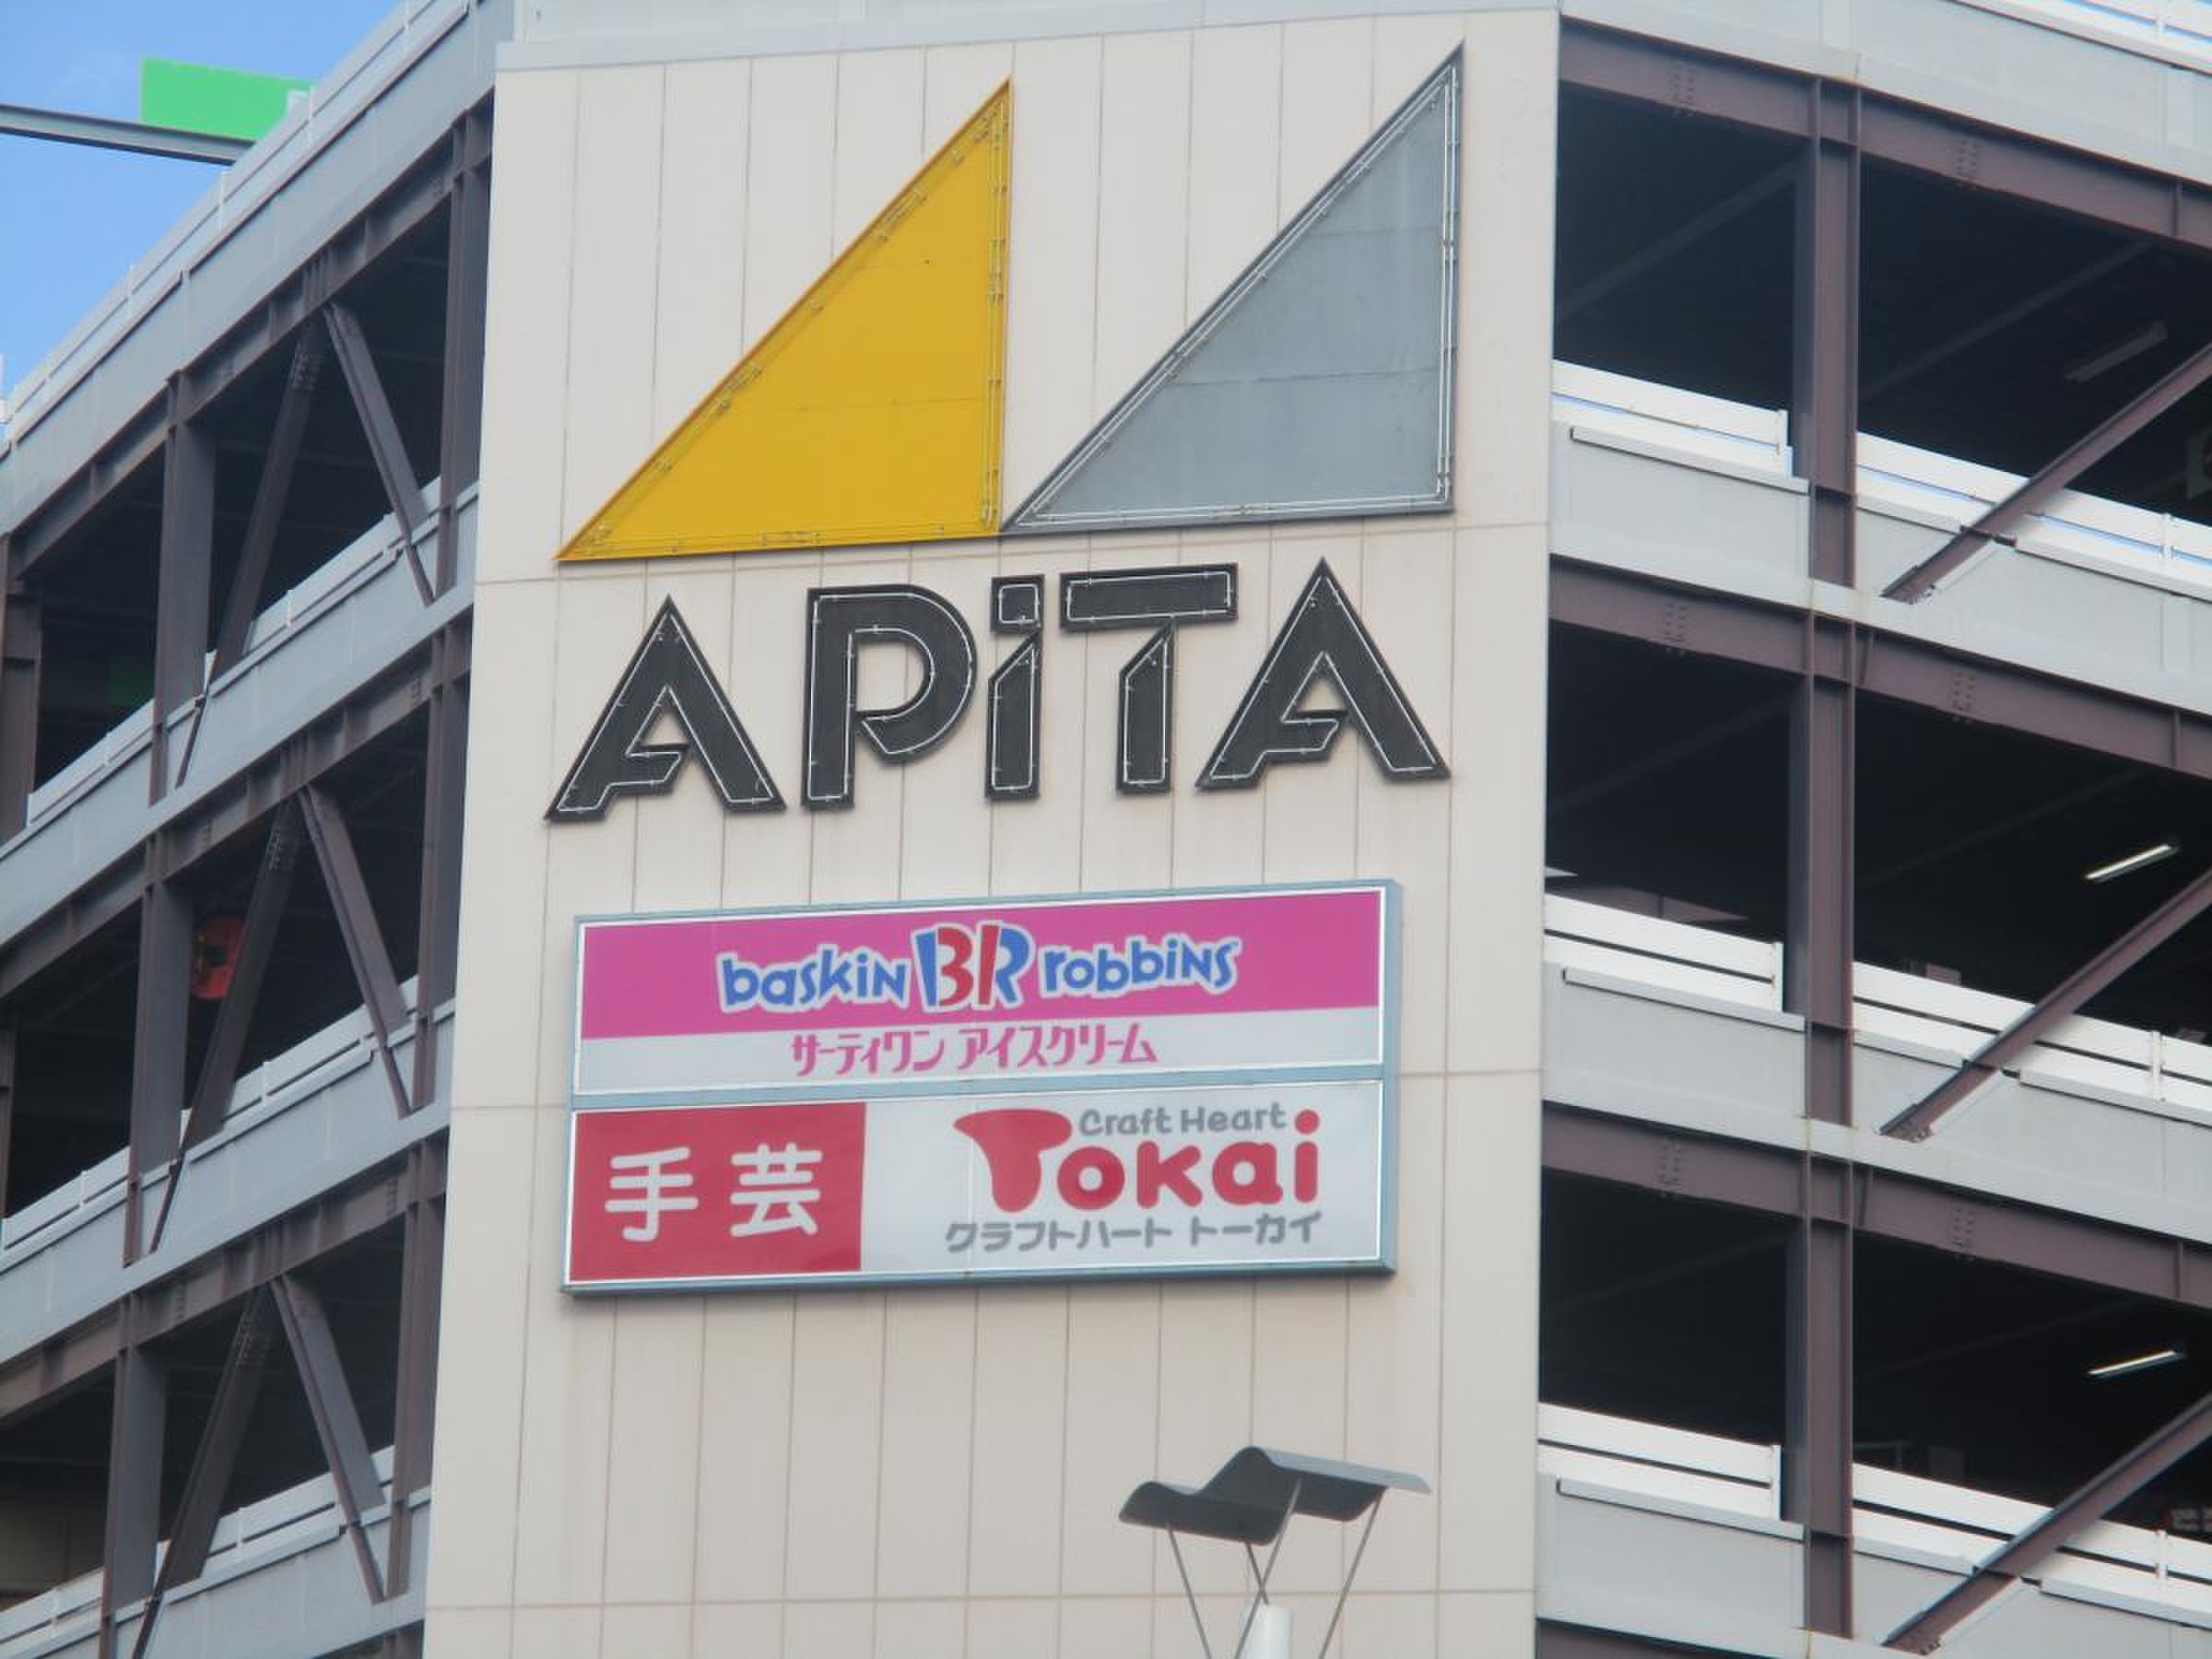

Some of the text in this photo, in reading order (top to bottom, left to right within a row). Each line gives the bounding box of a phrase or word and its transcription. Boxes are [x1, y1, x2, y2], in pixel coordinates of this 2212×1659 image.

[791, 1022, 1159, 1077] サーティワン アイスクリーム
[1079, 1102, 1288, 1135] Craft Heart
[952, 1109, 1320, 1213] Tokai
[604, 1142, 823, 1241] 手芸
[945, 1211, 1323, 1253] クラフトハート トーカイ
